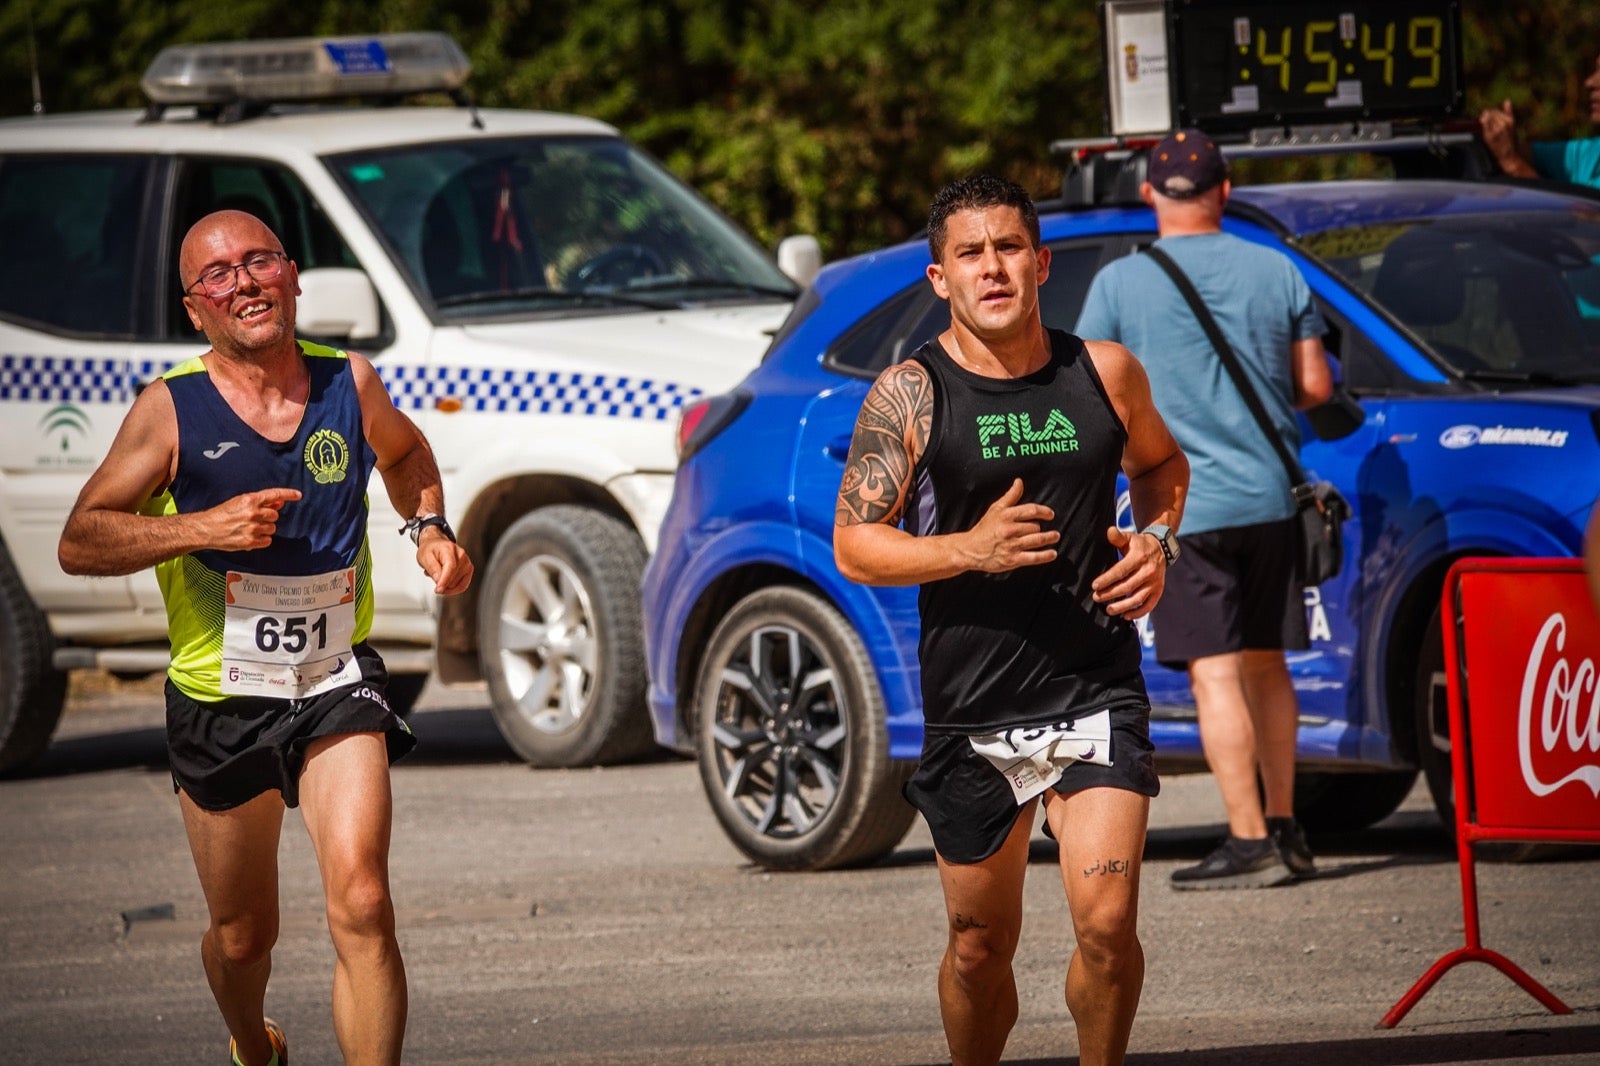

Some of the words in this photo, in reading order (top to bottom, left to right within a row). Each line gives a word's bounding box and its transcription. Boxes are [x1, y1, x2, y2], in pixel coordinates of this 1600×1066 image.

[976, 408, 1077, 447] FILA
[982, 446, 1001, 459] BE
[1006, 445, 1016, 457] A
[1020, 439, 1079, 456] RUNNER
[255, 612, 328, 654] 651
